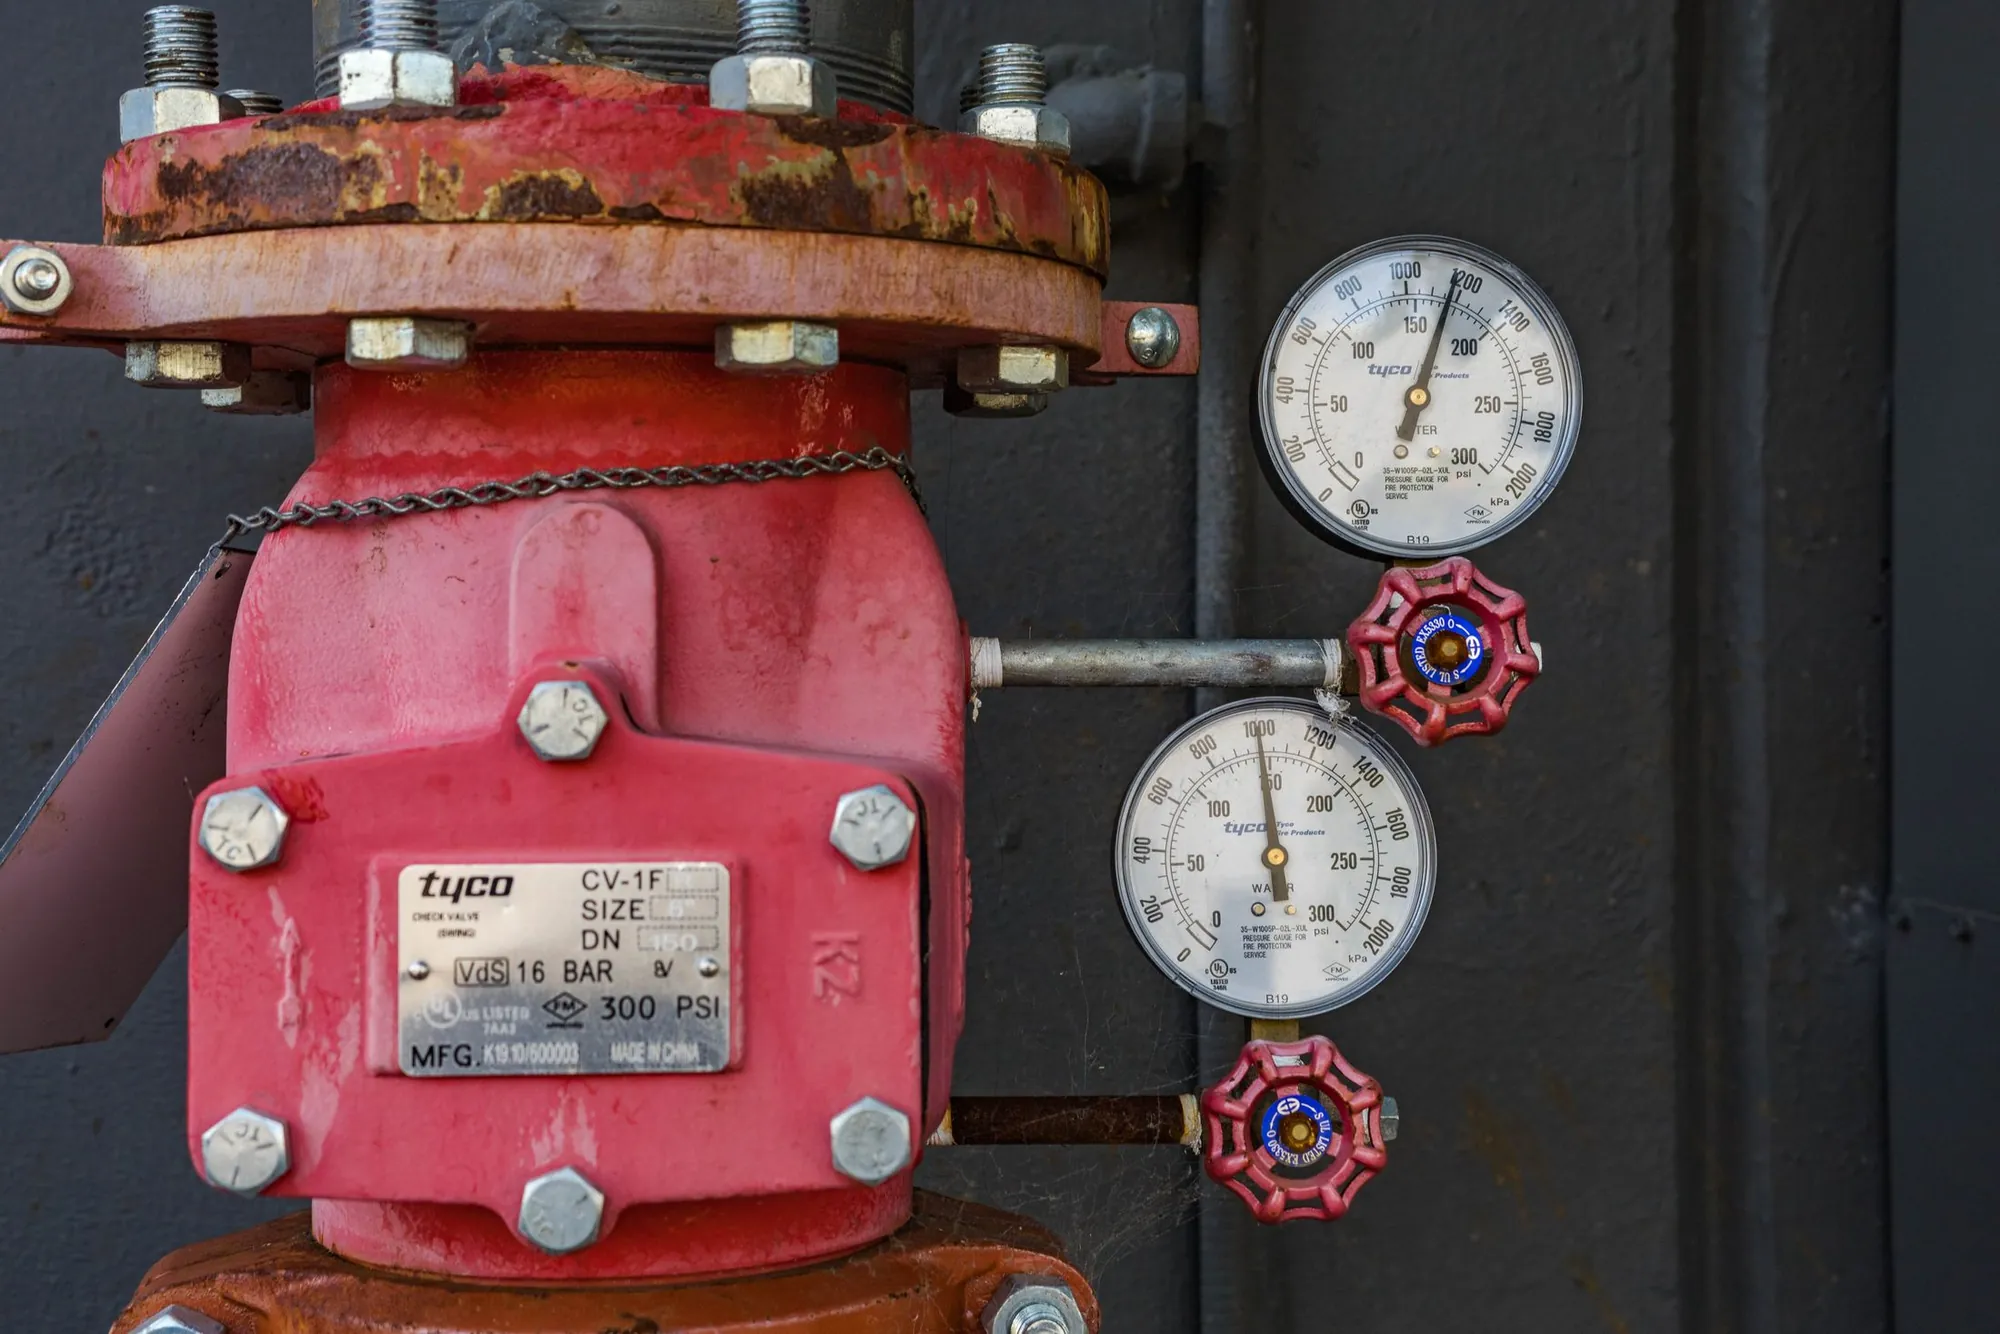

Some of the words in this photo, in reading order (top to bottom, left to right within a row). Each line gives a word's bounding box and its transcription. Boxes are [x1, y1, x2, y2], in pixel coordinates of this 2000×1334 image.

[1390, 262, 1421, 280] 1000
[1333, 275, 1363, 301] 800
[1404, 316, 1427, 334] 150
[1498, 299, 1530, 333] 1400
[1291, 317, 1317, 346] 600
[1351, 341, 1374, 359] 100
[1451, 338, 1478, 356] 200
[1367, 364, 1412, 378] tyco
[1530, 352, 1554, 385] 1600
[1276, 376, 1294, 404] 400
[1330, 395, 1348, 413] 50
[1474, 396, 1501, 414] 250
[1533, 411, 1556, 443] 1800
[1282, 435, 1306, 463] 200
[1451, 447, 1477, 465] 300
[1355, 451, 1363, 469] 0
[1456, 469, 1471, 479] psi
[1505, 463, 1537, 499] 2000
[1318, 487, 1333, 502] 0
[1385, 492, 1408, 500] SERVICE
[1490, 497, 1510, 506] kPa
[1355, 503, 1365, 514] UL
[1407, 535, 1430, 544] B19
[1416, 617, 1445, 643] EX5330
[1414, 646, 1437, 678] LISTED
[1439, 672, 1451, 683] UL
[1243, 719, 1275, 738] 1000
[1303, 724, 1336, 750] 1200
[1189, 734, 1217, 760] 800
[1352, 755, 1384, 788] 1400
[1147, 776, 1173, 806] 600
[1208, 800, 1230, 818] 100
[1307, 795, 1333, 813] 200
[1223, 821, 1268, 836] tyco
[1385, 807, 1409, 841] 1600
[1133, 836, 1151, 864] 400
[1187, 854, 1205, 872] 50
[1331, 852, 1357, 870] 250
[419, 871, 514, 904] tyco
[582, 869, 664, 891] CV-1F
[1252, 883, 1294, 893] WAR
[1390, 866, 1412, 899] 1800
[412, 912, 444, 922] CHECK
[447, 911, 480, 922] VALVE
[582, 899, 645, 920] SIZE
[1140, 895, 1164, 923] 200
[1309, 904, 1334, 922] 300
[1212, 910, 1221, 928] 0
[582, 929, 620, 950] DN
[1314, 927, 1329, 937] psi
[1363, 919, 1394, 955] 2000
[1177, 947, 1191, 962] 0
[1257, 942, 1292, 950] PROTECTION
[1348, 954, 1367, 963] kPa
[459, 959, 505, 983] VdS
[517, 960, 545, 984] 16
[563, 959, 613, 983] BAR
[1214, 963, 1224, 974] UL
[601, 995, 656, 1020] 300
[676, 995, 719, 1019] PSI
[1266, 994, 1289, 1004] B19
[483, 1006, 530, 1021] LISTED
[411, 1044, 481, 1068] MFG.
[610, 1041, 646, 1063] MADE
[647, 1042, 660, 1062] IN
[662, 1041, 700, 1062] CHINA
[1319, 1119, 1331, 1133] UL
[1266, 1139, 1299, 1166] EX5330
[1303, 1135, 1329, 1164] LISTED
